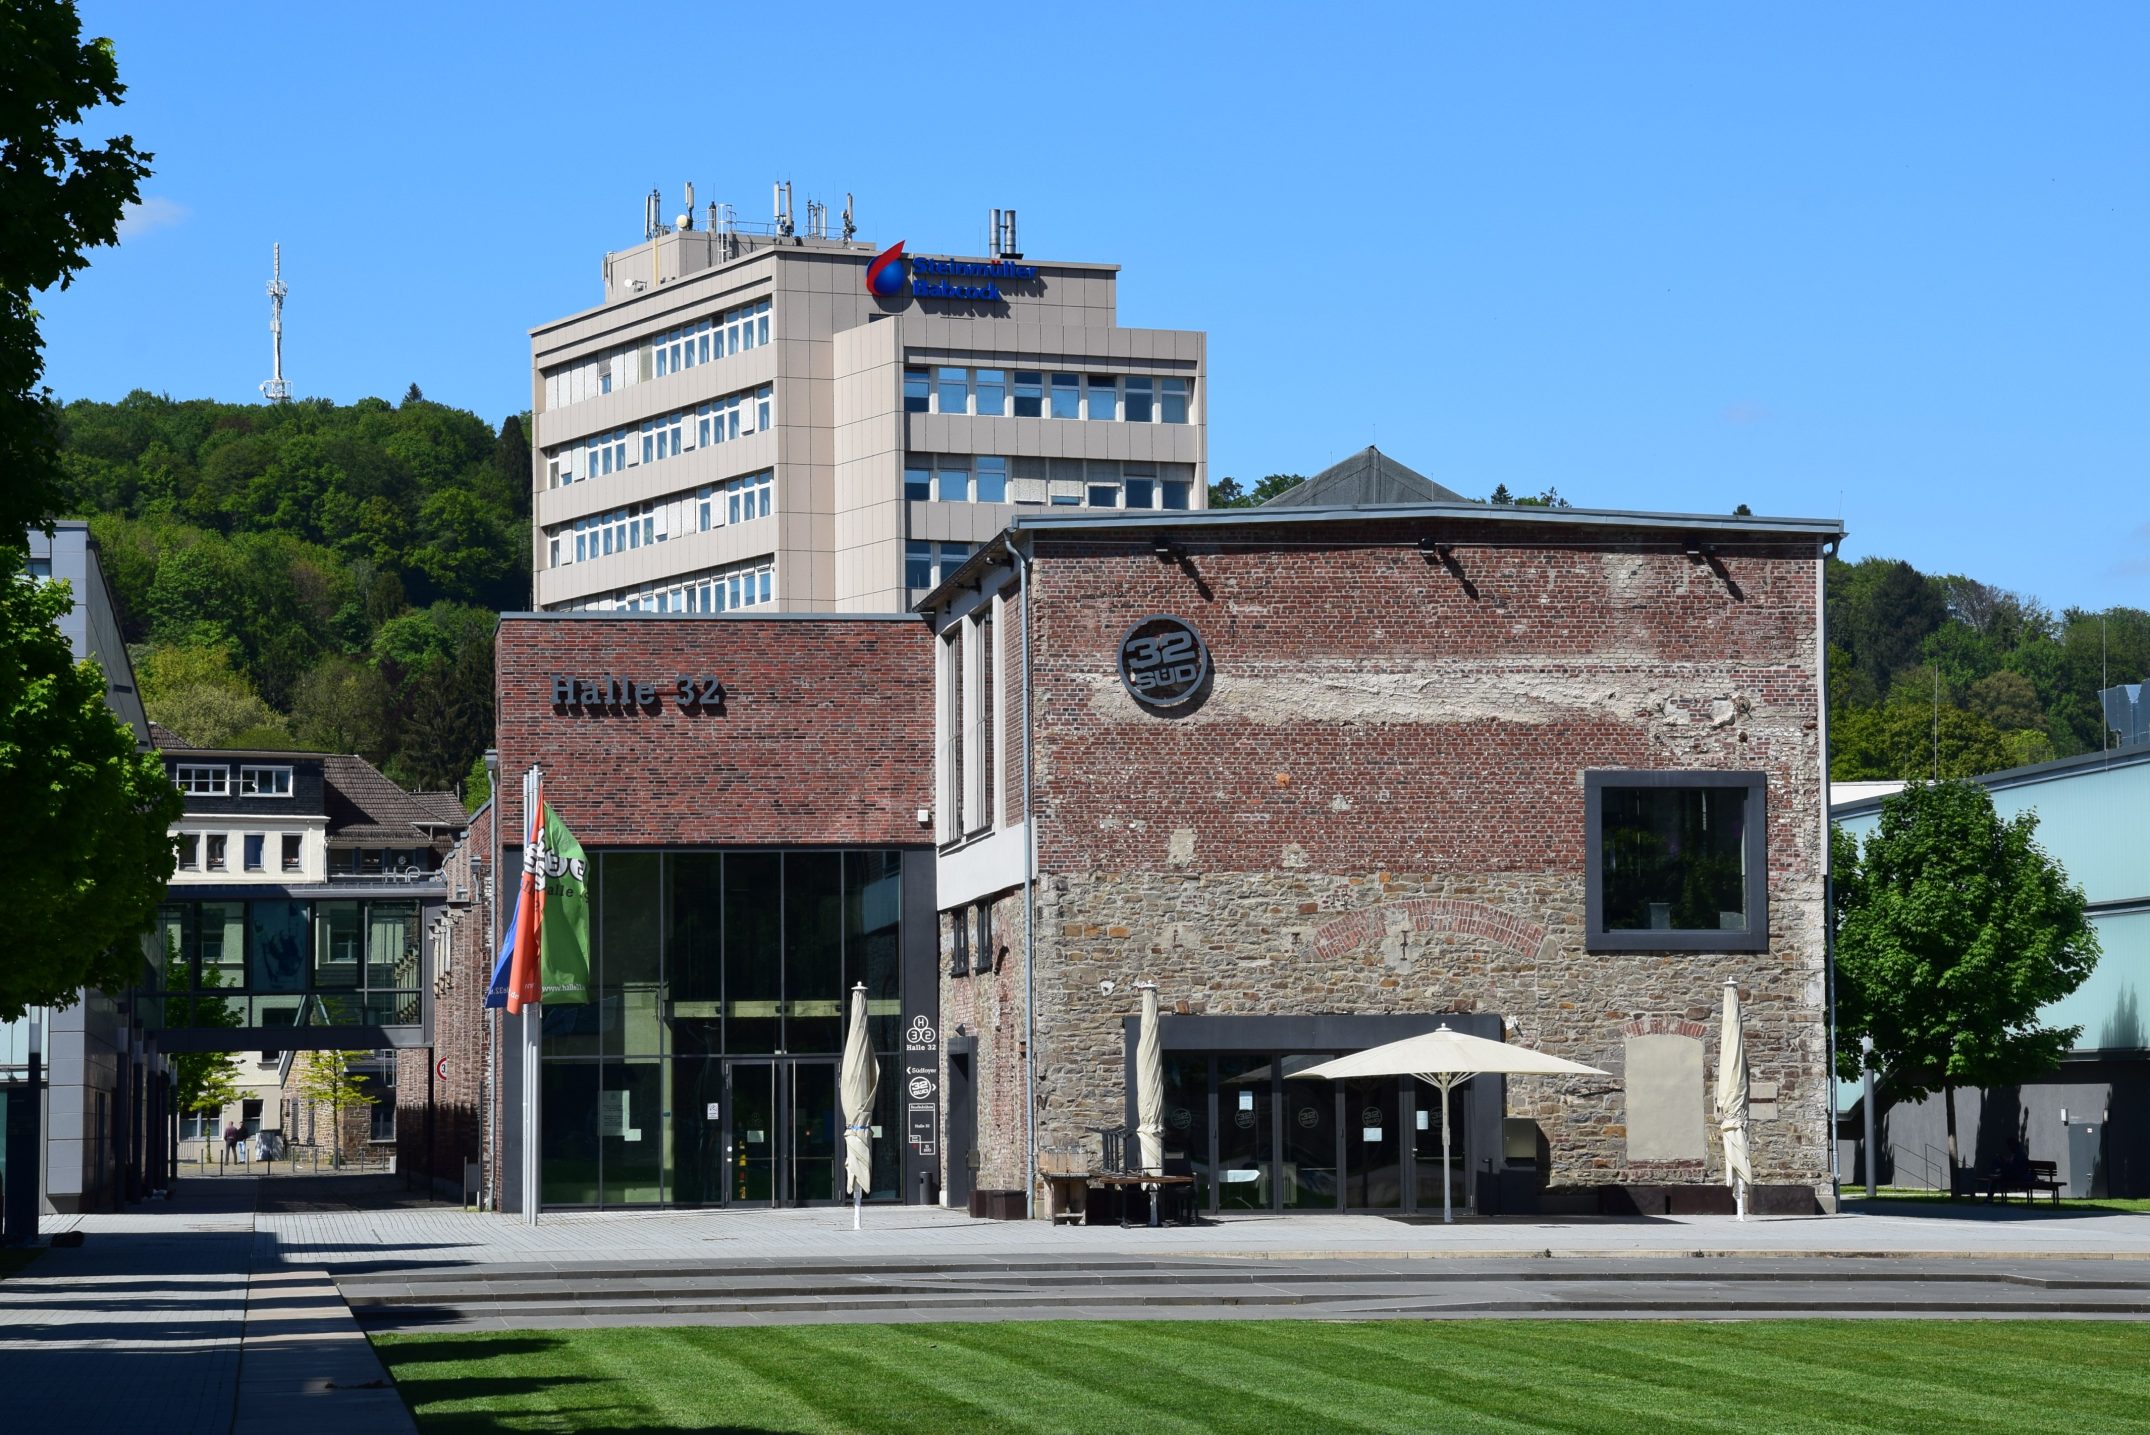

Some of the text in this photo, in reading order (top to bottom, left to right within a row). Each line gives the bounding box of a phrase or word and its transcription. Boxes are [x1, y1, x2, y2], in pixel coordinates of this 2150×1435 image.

[912, 257, 1038, 280] Steinmüller
[912, 279, 1001, 301] Babcock
[1126, 631, 1196, 668] 32
[1135, 664, 1197, 690] SÜD
[550, 674, 720, 705] Halle 32
[911, 1080, 929, 1091] 32
